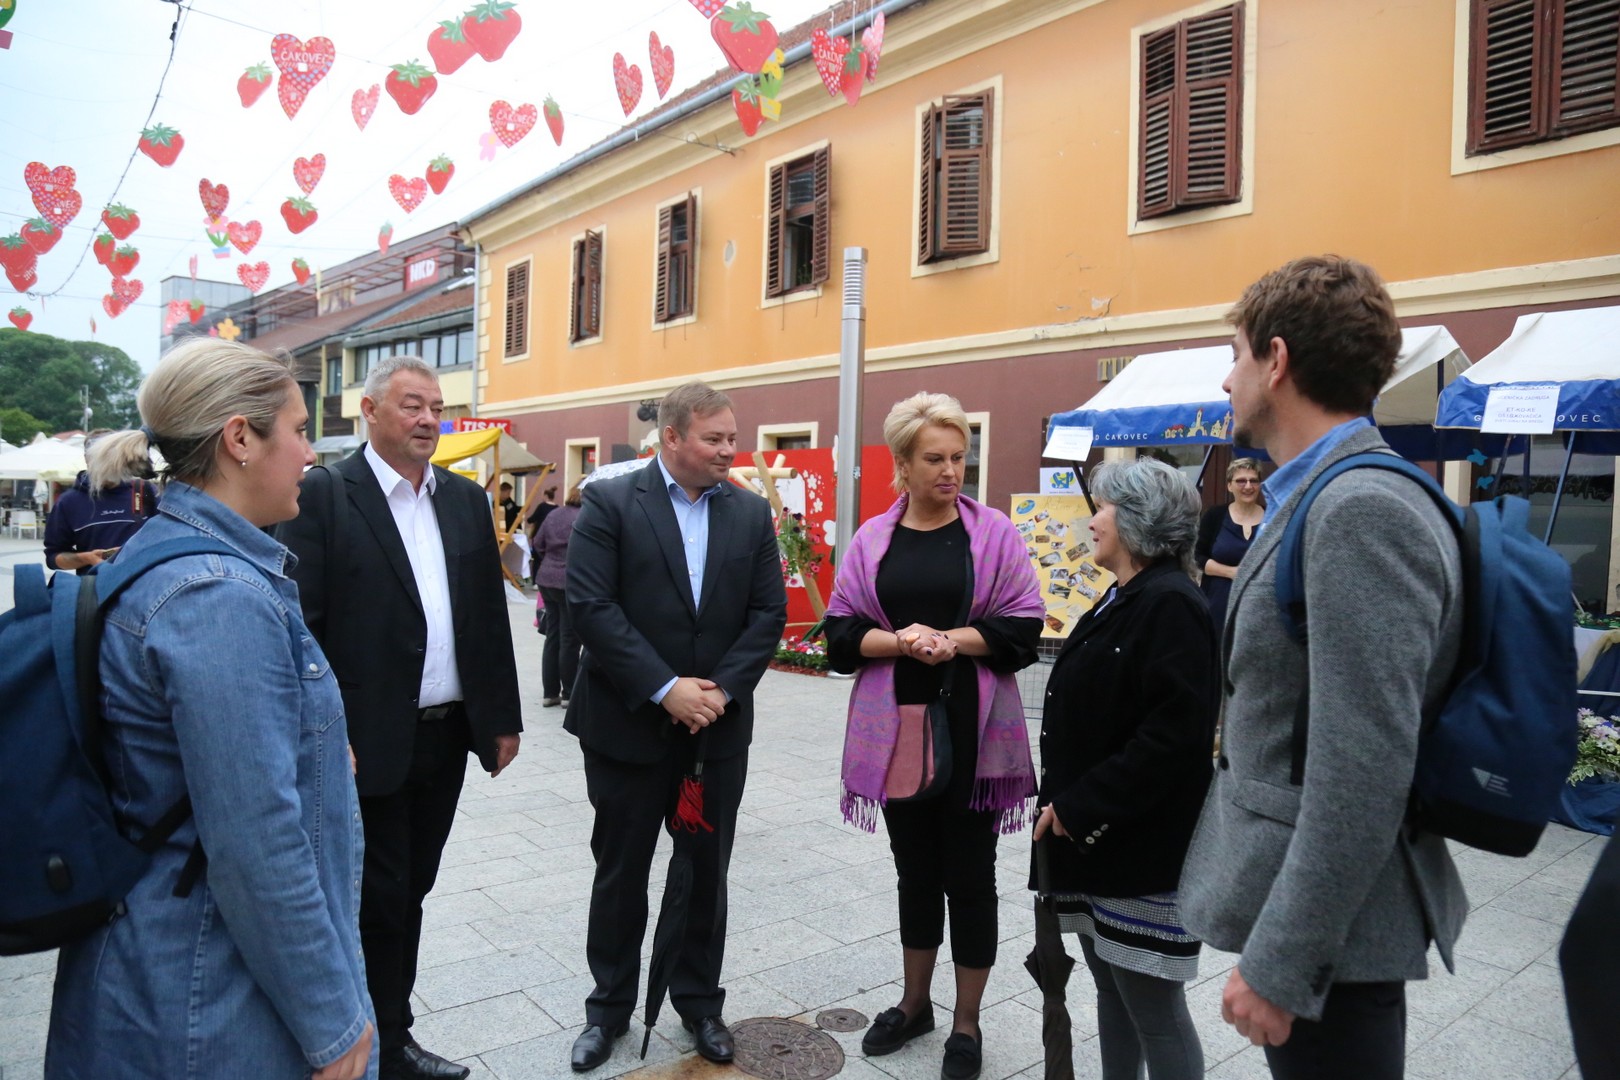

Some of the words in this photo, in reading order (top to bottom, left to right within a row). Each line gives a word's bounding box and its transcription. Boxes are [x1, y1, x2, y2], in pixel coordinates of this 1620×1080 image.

[281, 48, 328, 63] ČAKOVEC
[818, 45, 845, 64] ČAKOVE
[1557, 414, 1601, 423] OVEC
[1105, 432, 1148, 441] ČAKOVEC
